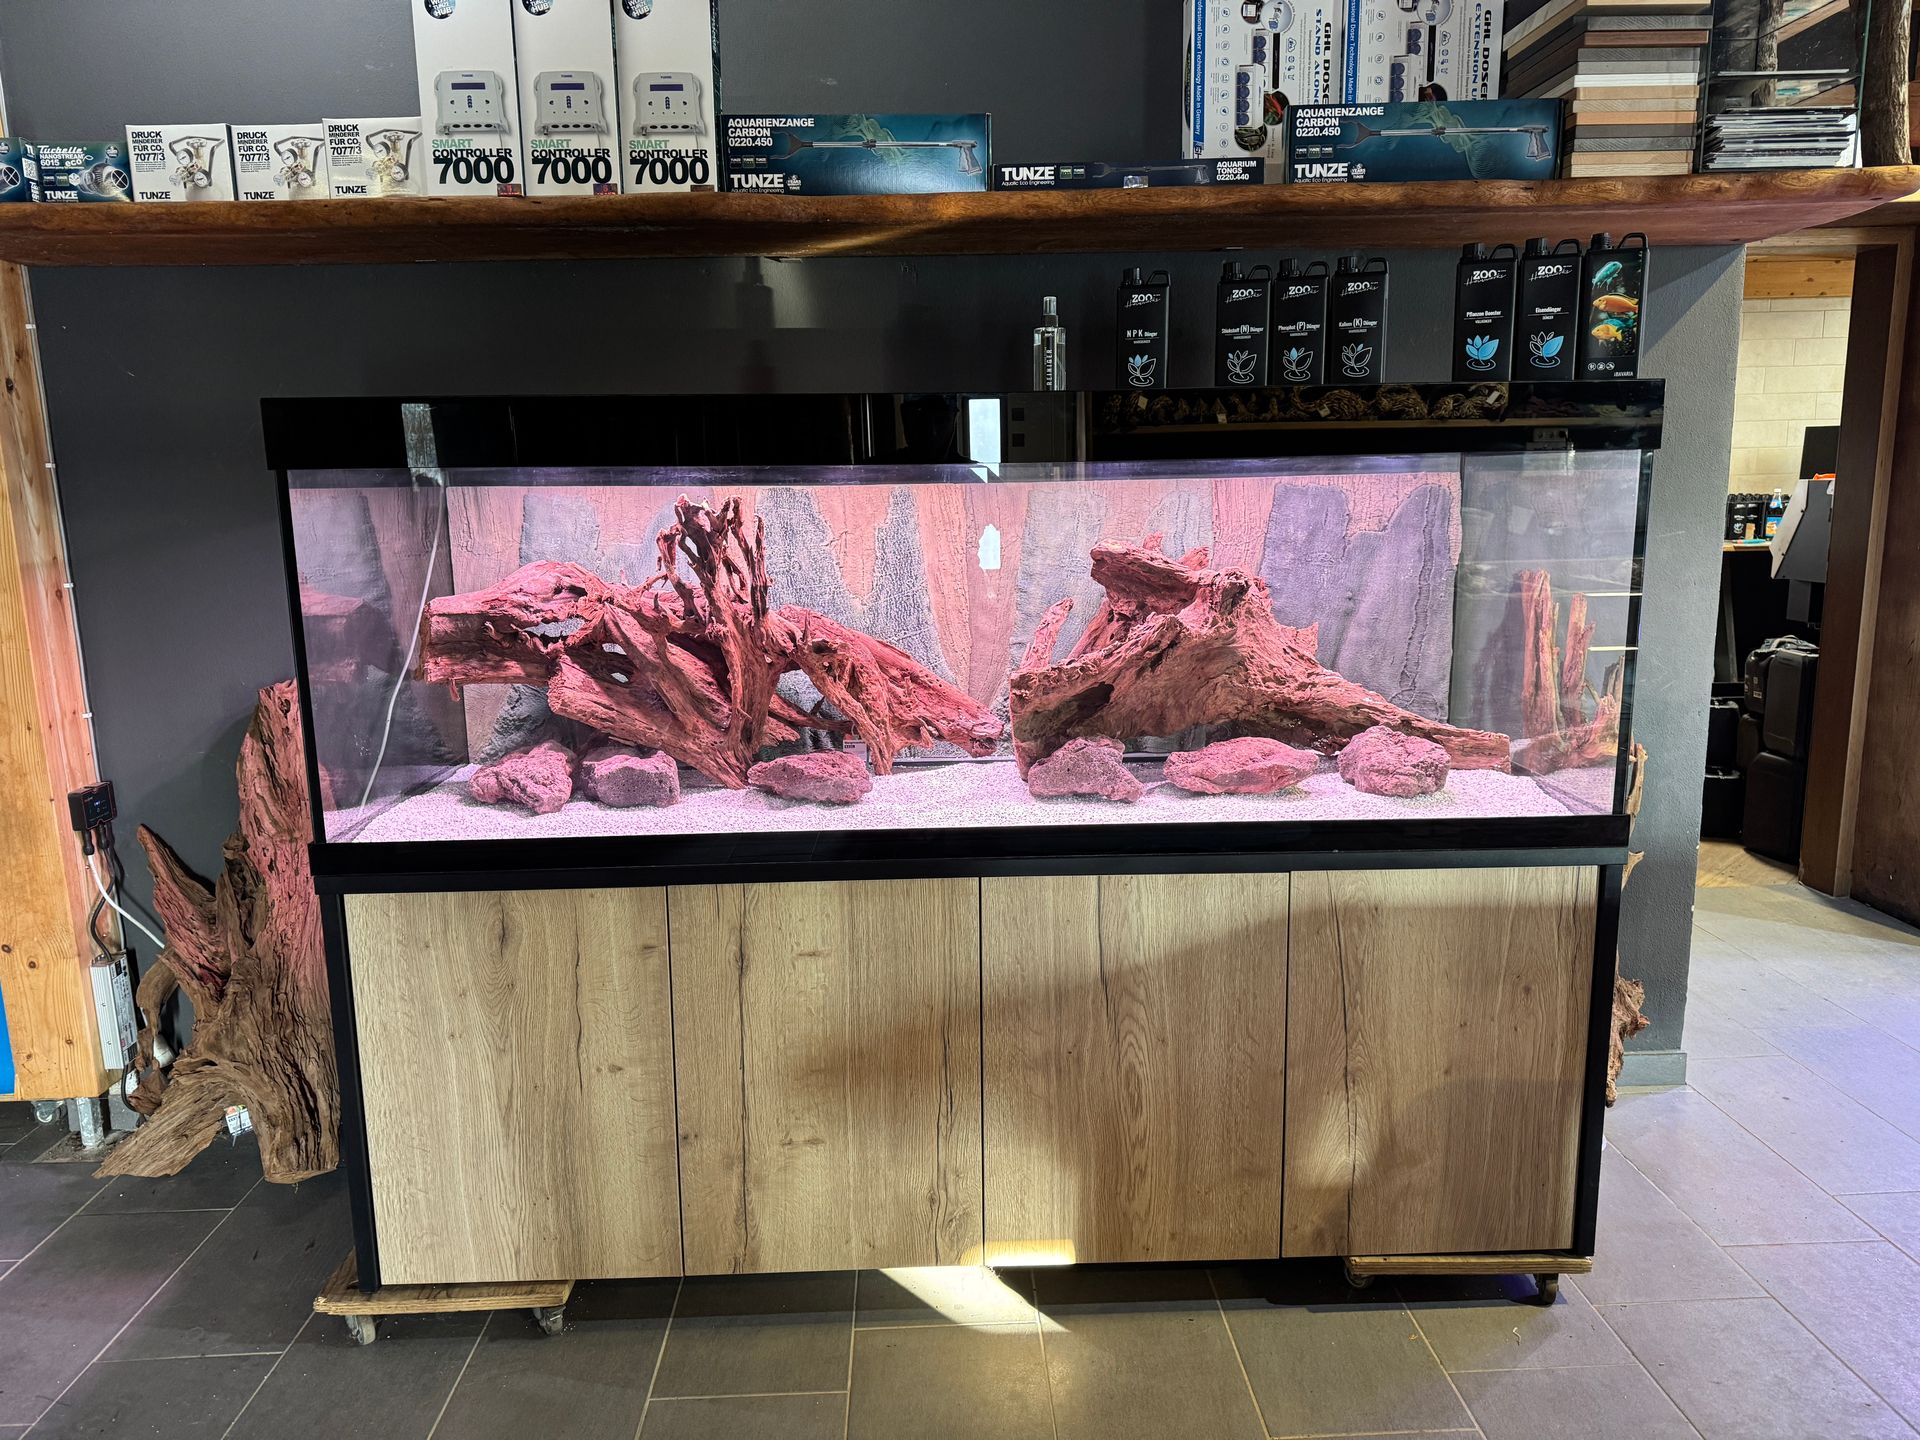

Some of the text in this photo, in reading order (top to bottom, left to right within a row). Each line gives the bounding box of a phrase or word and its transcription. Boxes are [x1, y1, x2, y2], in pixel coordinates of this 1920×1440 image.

[1314, 8, 1322, 55] STAND
[1483, 9, 1492, 44] GHL
[1323, 22, 1332, 56] GHL
[1471, 2, 1482, 84] EXTENSION
[1296, 106, 1384, 118] AQUARIENZANGE
[727, 118, 815, 127] AQUARIENZANGE
[1296, 118, 1339, 127] CARBON
[328, 124, 359, 132] DRUCK
[728, 128, 770, 137] CARBON
[1296, 127, 1340, 137] 0220.450
[237, 131, 267, 139] DRUCK
[432, 139, 473, 148] SMART
[531, 139, 571, 148] SMART
[629, 139, 670, 149] SMART
[728, 138, 773, 146] 0220.450
[433, 148, 513, 158] CONTROLLER
[531, 148, 611, 158] CONTROLLER
[629, 149, 708, 159] CONTROLLER
[433, 157, 514, 184] 7000
[531, 157, 612, 184] 7000
[629, 157, 709, 185] 7000
[1001, 166, 1055, 181] TUNZE
[1294, 162, 1348, 178] TUNZE
[730, 173, 784, 188] TUNZE
[335, 185, 367, 194] TUNZE
[45, 191, 78, 200] TUNZE
[139, 191, 171, 200] TUNZE
[243, 191, 275, 200] TUNZE
[1472, 269, 1497, 280] ZOO
[1538, 264, 1562, 276] ZOO
[1288, 285, 1311, 295] ZOO
[1347, 281, 1370, 291] ZOO
[1132, 293, 1153, 303] ZOO
[1232, 288, 1254, 298] ZOO
[1296, 321, 1306, 331] (P)
[1352, 318, 1363, 328] (K)
[1240, 324, 1250, 334] (N)
